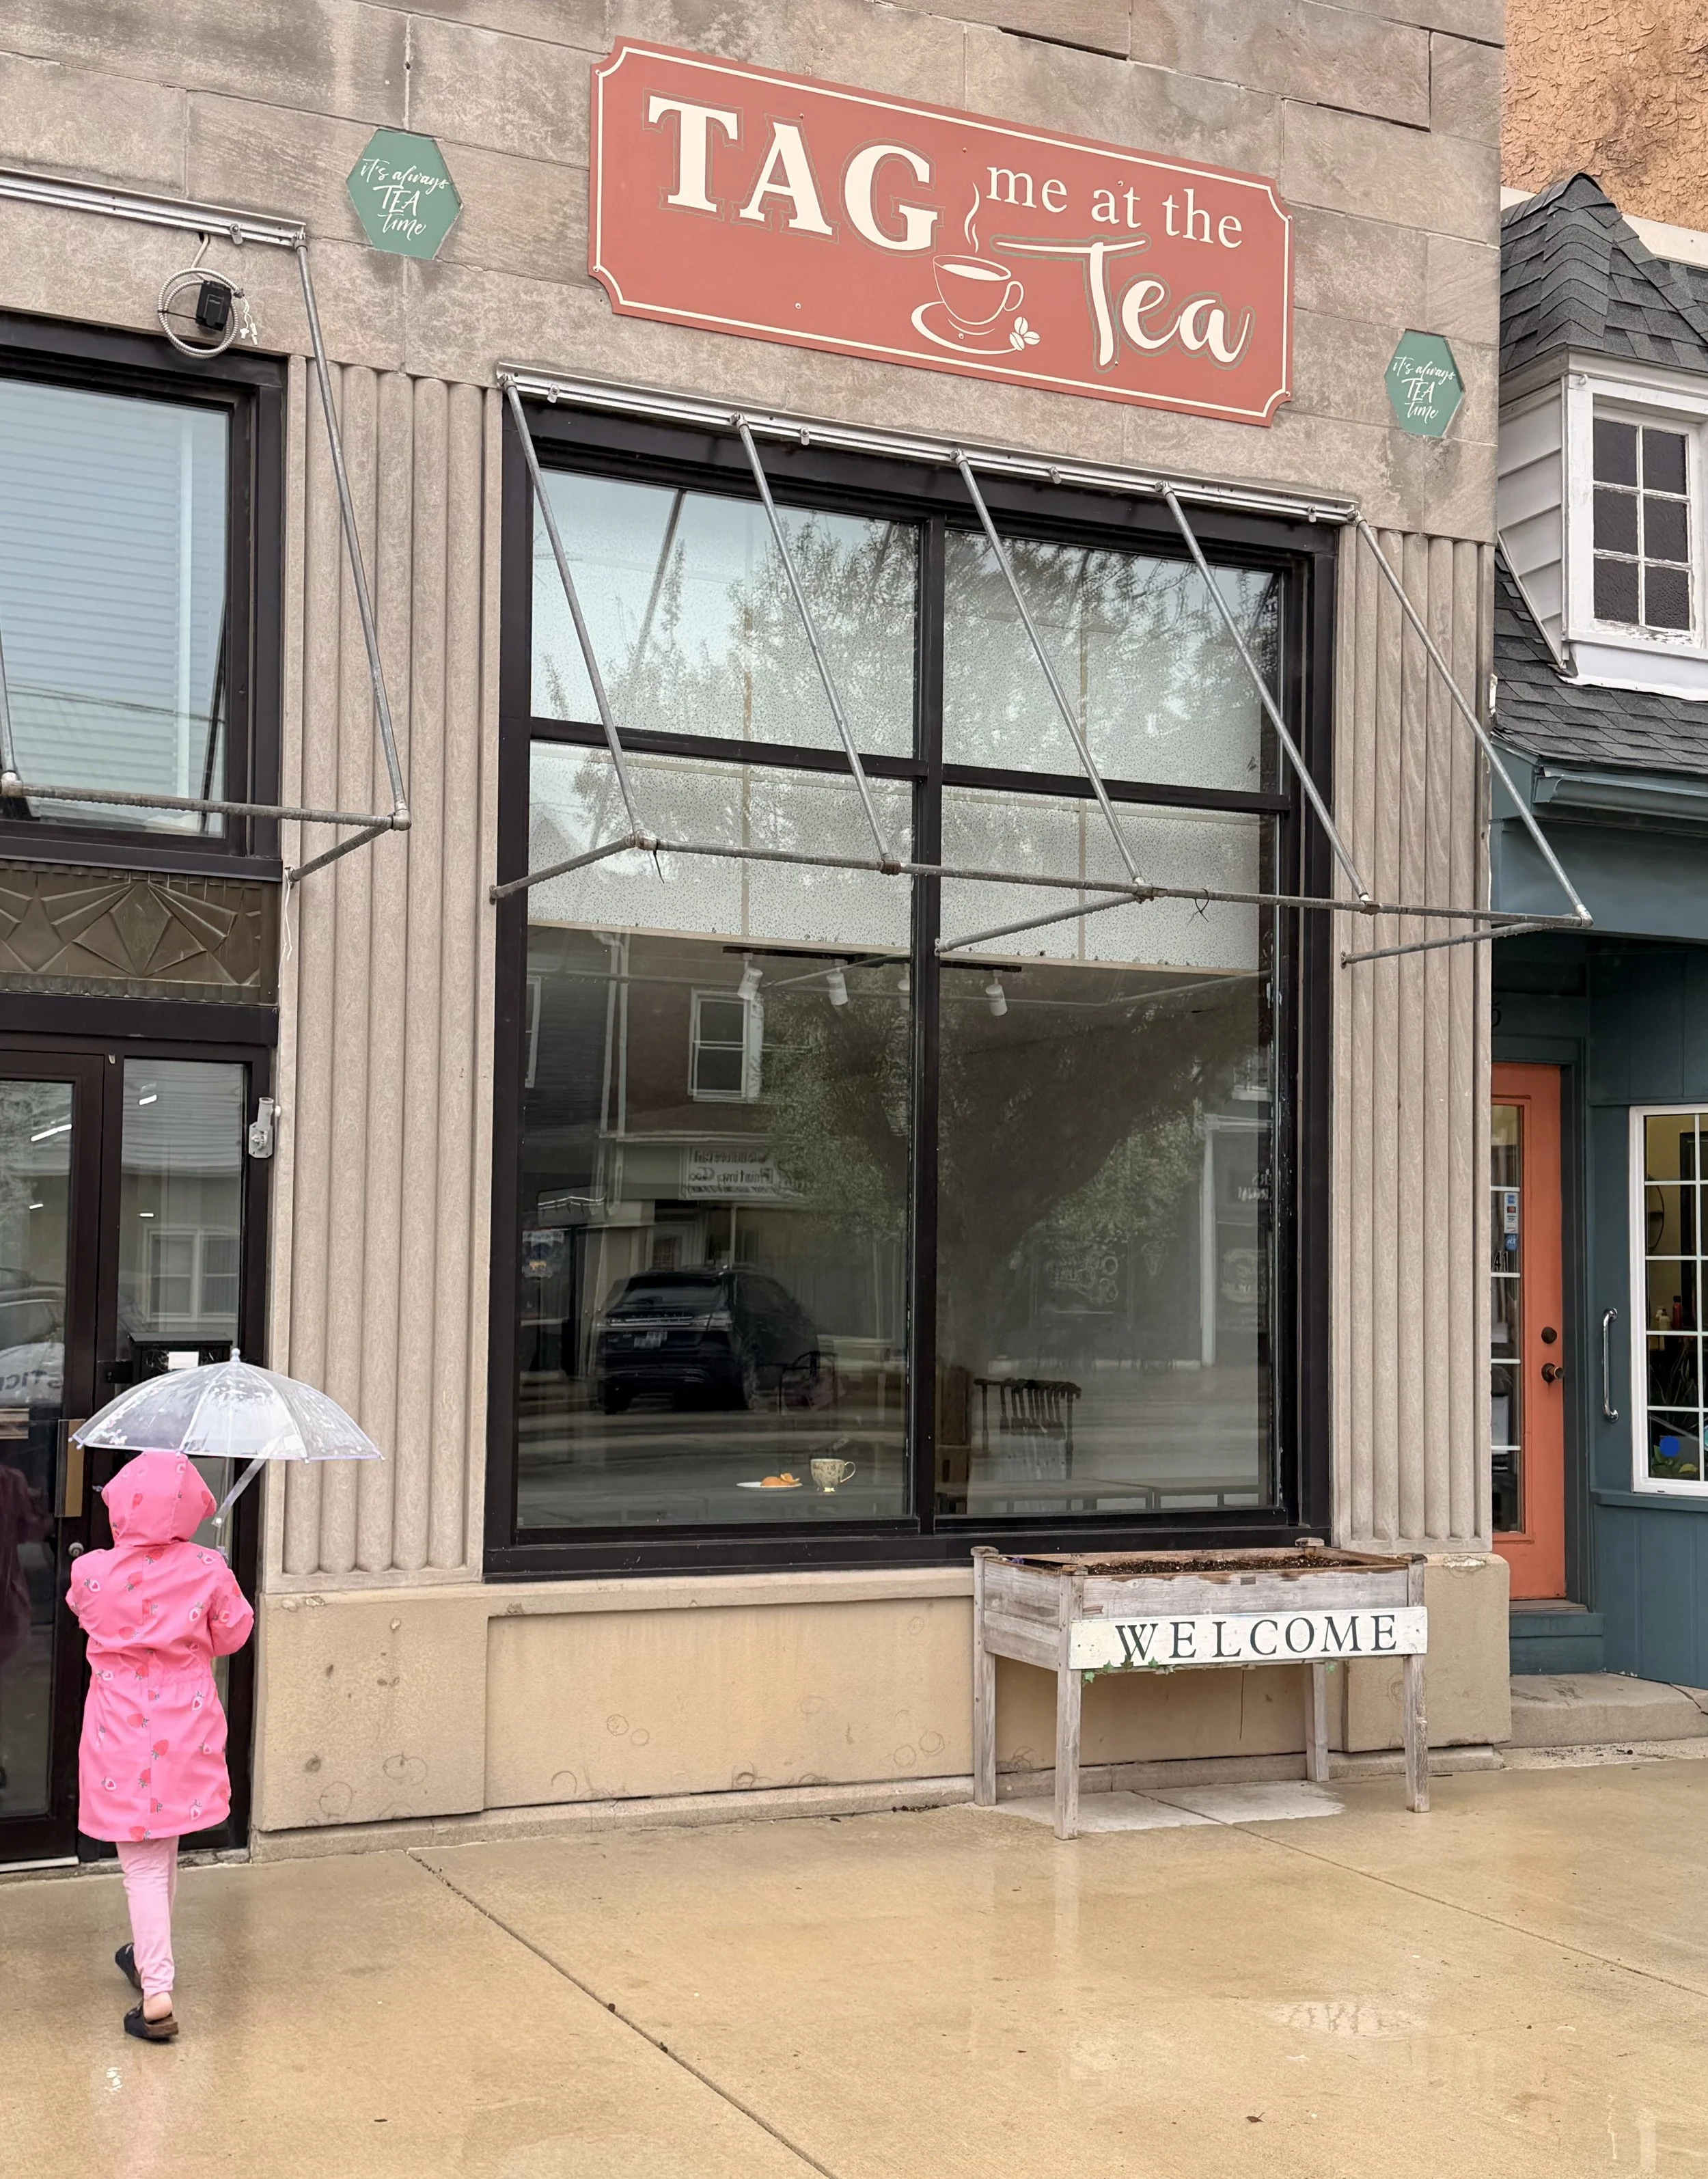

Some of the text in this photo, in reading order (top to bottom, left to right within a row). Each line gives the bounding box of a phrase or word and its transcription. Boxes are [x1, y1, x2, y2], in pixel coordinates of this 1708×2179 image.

[391, 165, 450, 195] always
[646, 94, 1243, 253] TAG me at the
[373, 184, 420, 217] TEA
[995, 238, 1250, 368] Tea
[1415, 361, 1456, 385] always
[1401, 378, 1435, 403] TEA
[1114, 1615, 1397, 1661] WELCOME
